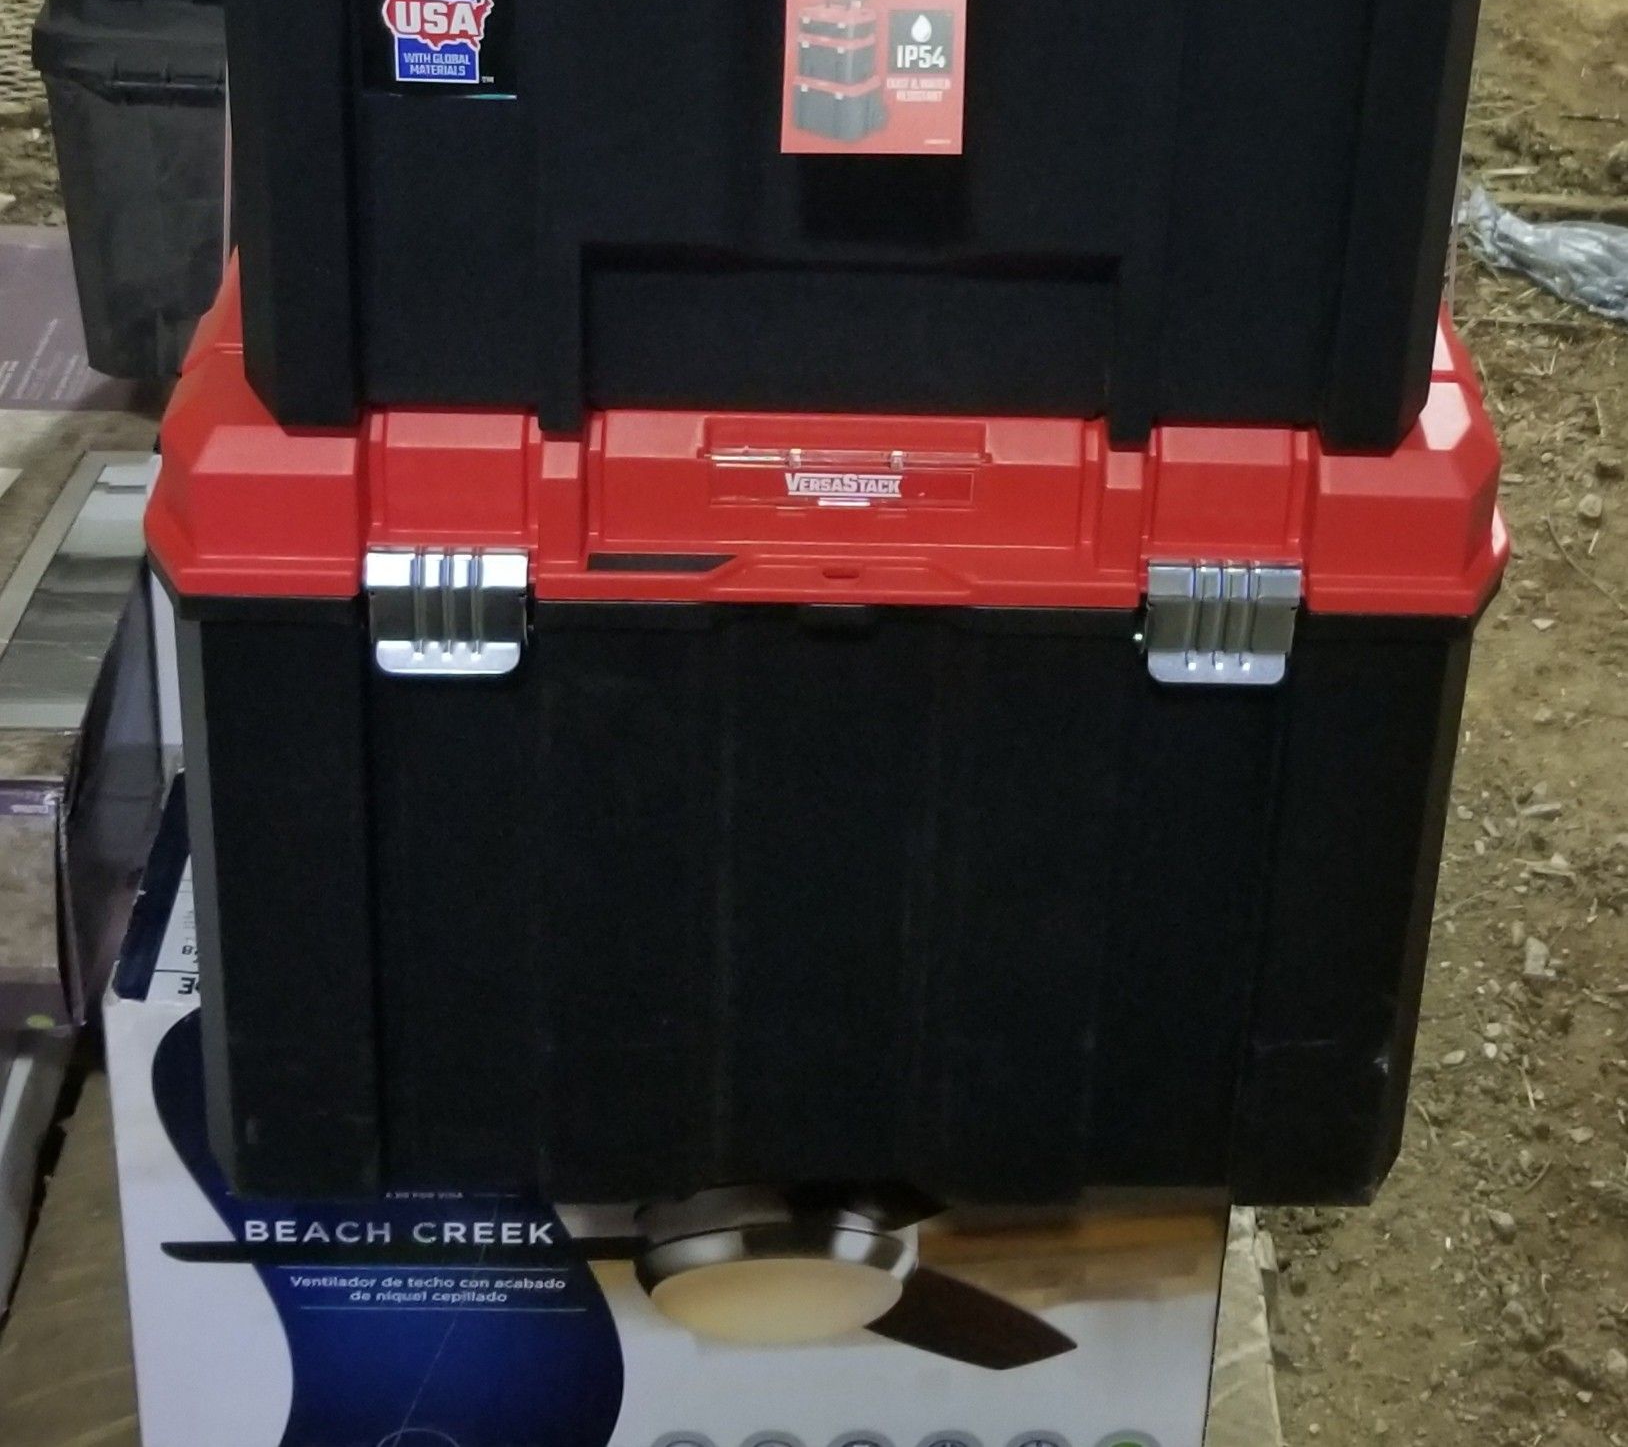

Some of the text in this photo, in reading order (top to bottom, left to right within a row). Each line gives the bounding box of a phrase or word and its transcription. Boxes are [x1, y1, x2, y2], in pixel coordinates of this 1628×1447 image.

[394, 1, 479, 35] USA
[403, 52, 471, 65] WITH GLOBAL
[896, 45, 946, 69] IP54
[409, 64, 466, 76] MATERIALS
[244, 1220, 554, 1245] BEACH CREEK
[290, 1275, 566, 1290] Ventilador de techo con acabado
[350, 1290, 371, 1301] de
[431, 1291, 508, 1304] cepillado
